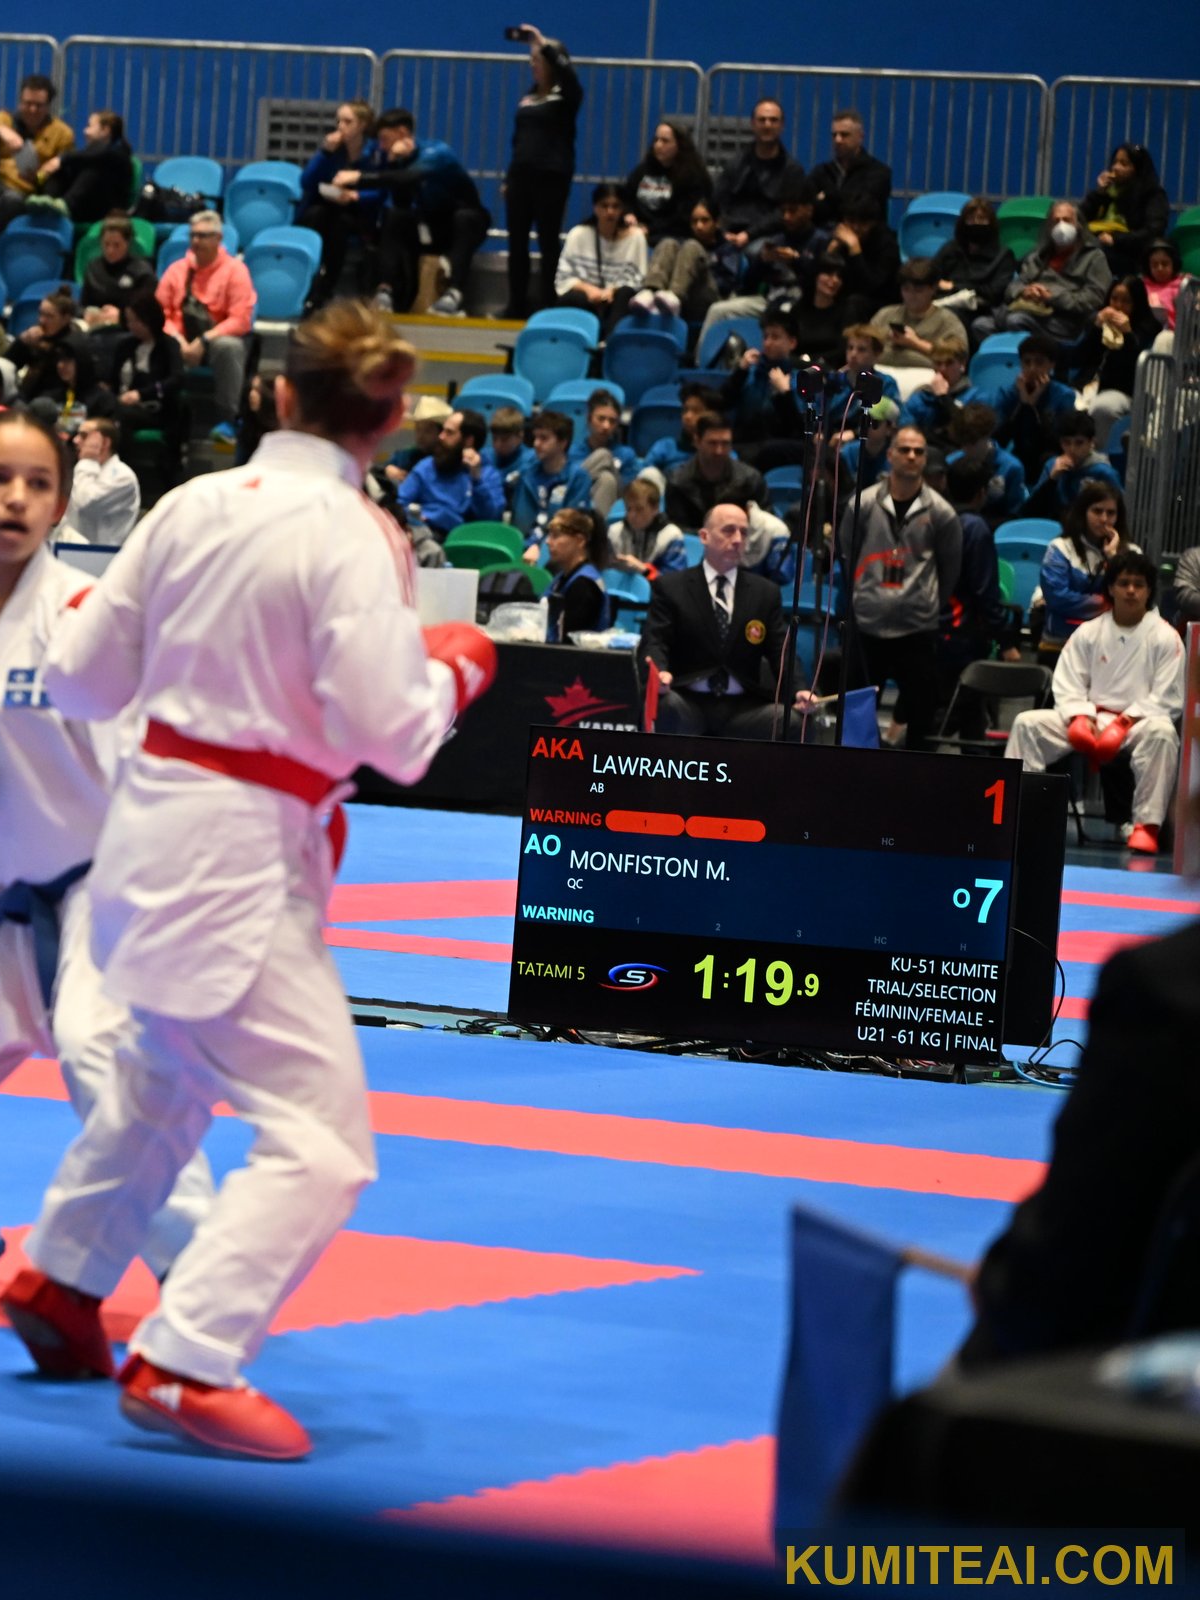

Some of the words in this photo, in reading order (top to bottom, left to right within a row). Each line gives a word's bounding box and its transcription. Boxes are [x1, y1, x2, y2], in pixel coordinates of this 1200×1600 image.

[532, 737, 584, 760] AKA
[592, 754, 709, 782] LAWRANCE
[715, 763, 732, 783] S.
[589, 783, 605, 794] AB
[984, 779, 1005, 825] 1
[529, 808, 602, 826] WARNING
[722, 825, 729, 834] 2
[803, 831, 809, 840] 3
[524, 833, 562, 856] AO
[881, 837, 895, 846] HC
[967, 844, 974, 852] H
[569, 850, 698, 878] MONFISTON
[705, 860, 730, 881] M.
[566, 878, 584, 890] QC
[522, 905, 595, 924] WARNING
[715, 923, 721, 932] 2
[796, 929, 802, 938] 3
[873, 936, 888, 945] HC
[959, 943, 967, 951] H
[517, 961, 572, 980] TATAMI
[577, 966, 585, 981] 5
[891, 956, 935, 974] KU-51
[941, 961, 999, 980] KUMITE
[867, 978, 997, 1003] TRIAL/SELECTION
[855, 999, 983, 1026] FÉMININ/FEMALE
[857, 1026, 885, 1042] U21
[891, 1030, 914, 1045] -61
[920, 1032, 941, 1047] KG
[954, 1035, 998, 1052] FINAL
